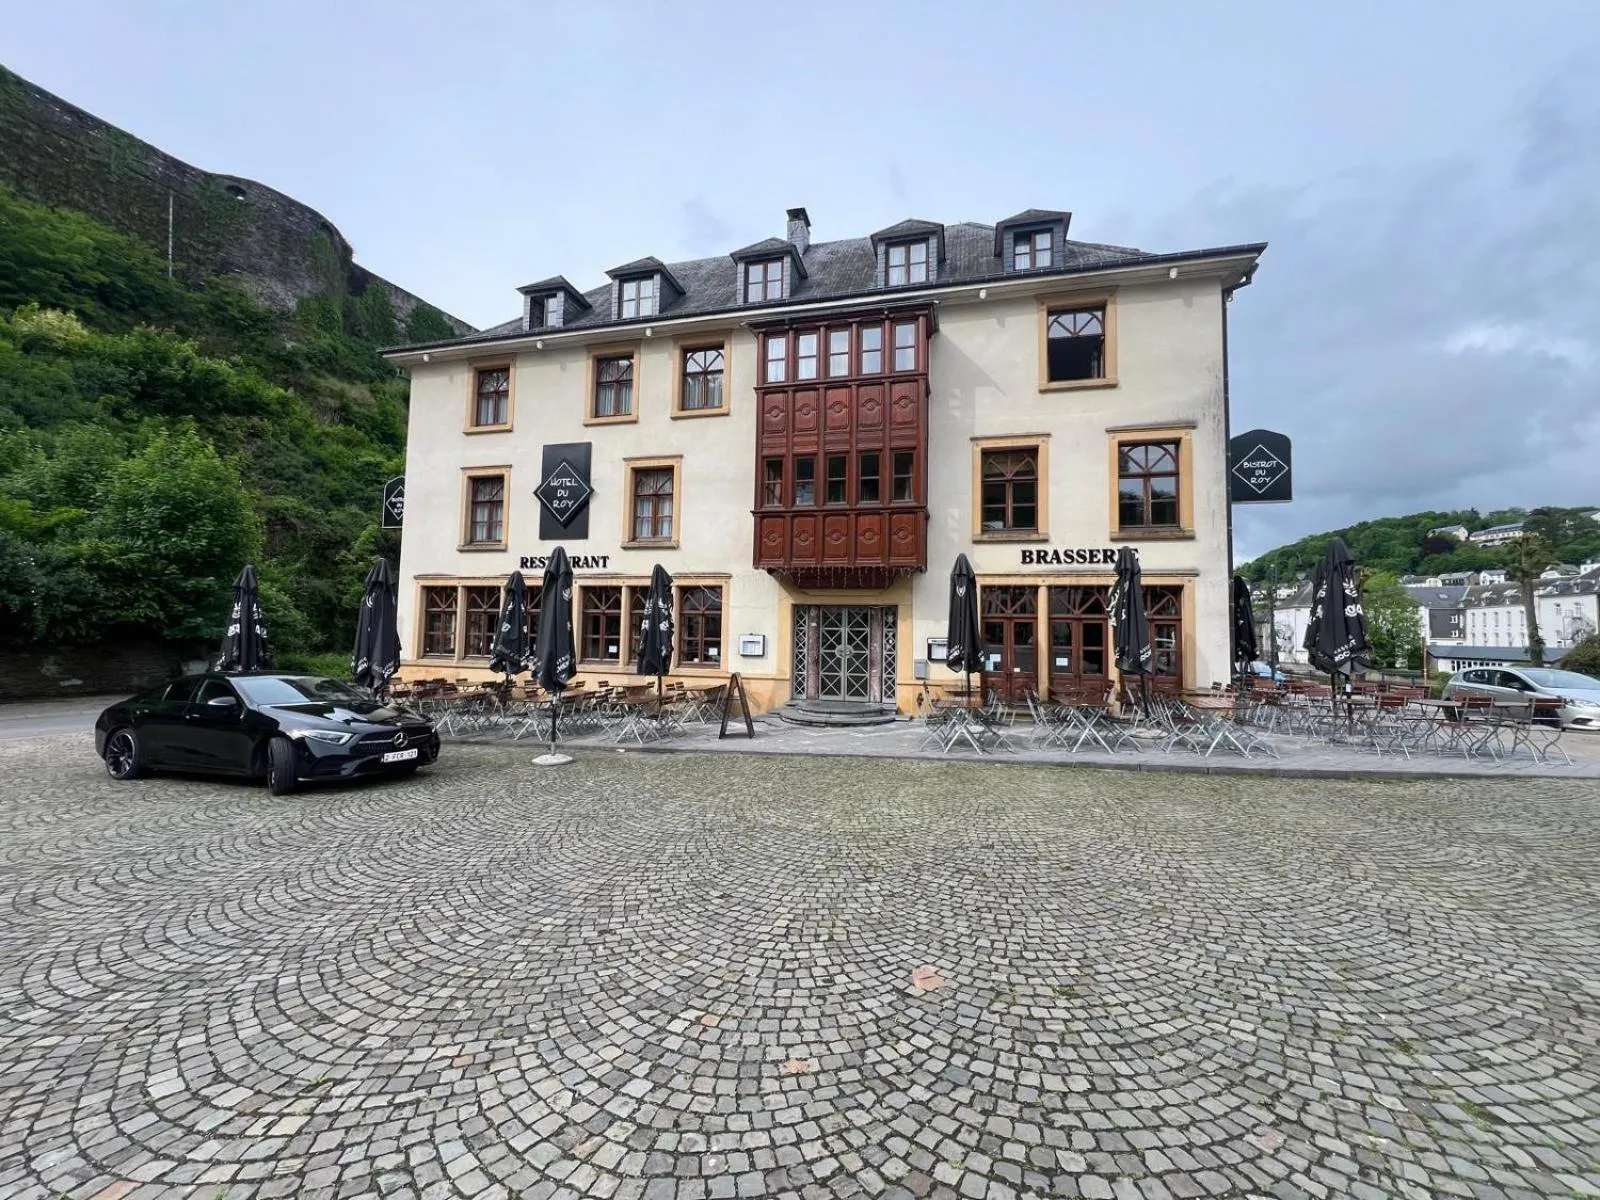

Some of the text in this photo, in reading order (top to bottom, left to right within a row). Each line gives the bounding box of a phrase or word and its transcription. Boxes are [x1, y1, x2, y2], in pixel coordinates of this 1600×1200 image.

[1243, 460, 1278, 469] BISTROT
[549, 477, 578, 487] HOTEL
[557, 489, 569, 497] DU
[553, 500, 575, 508] ROY
[1020, 548, 1139, 565] BRASSERE
[519, 555, 610, 569] RESRANT
